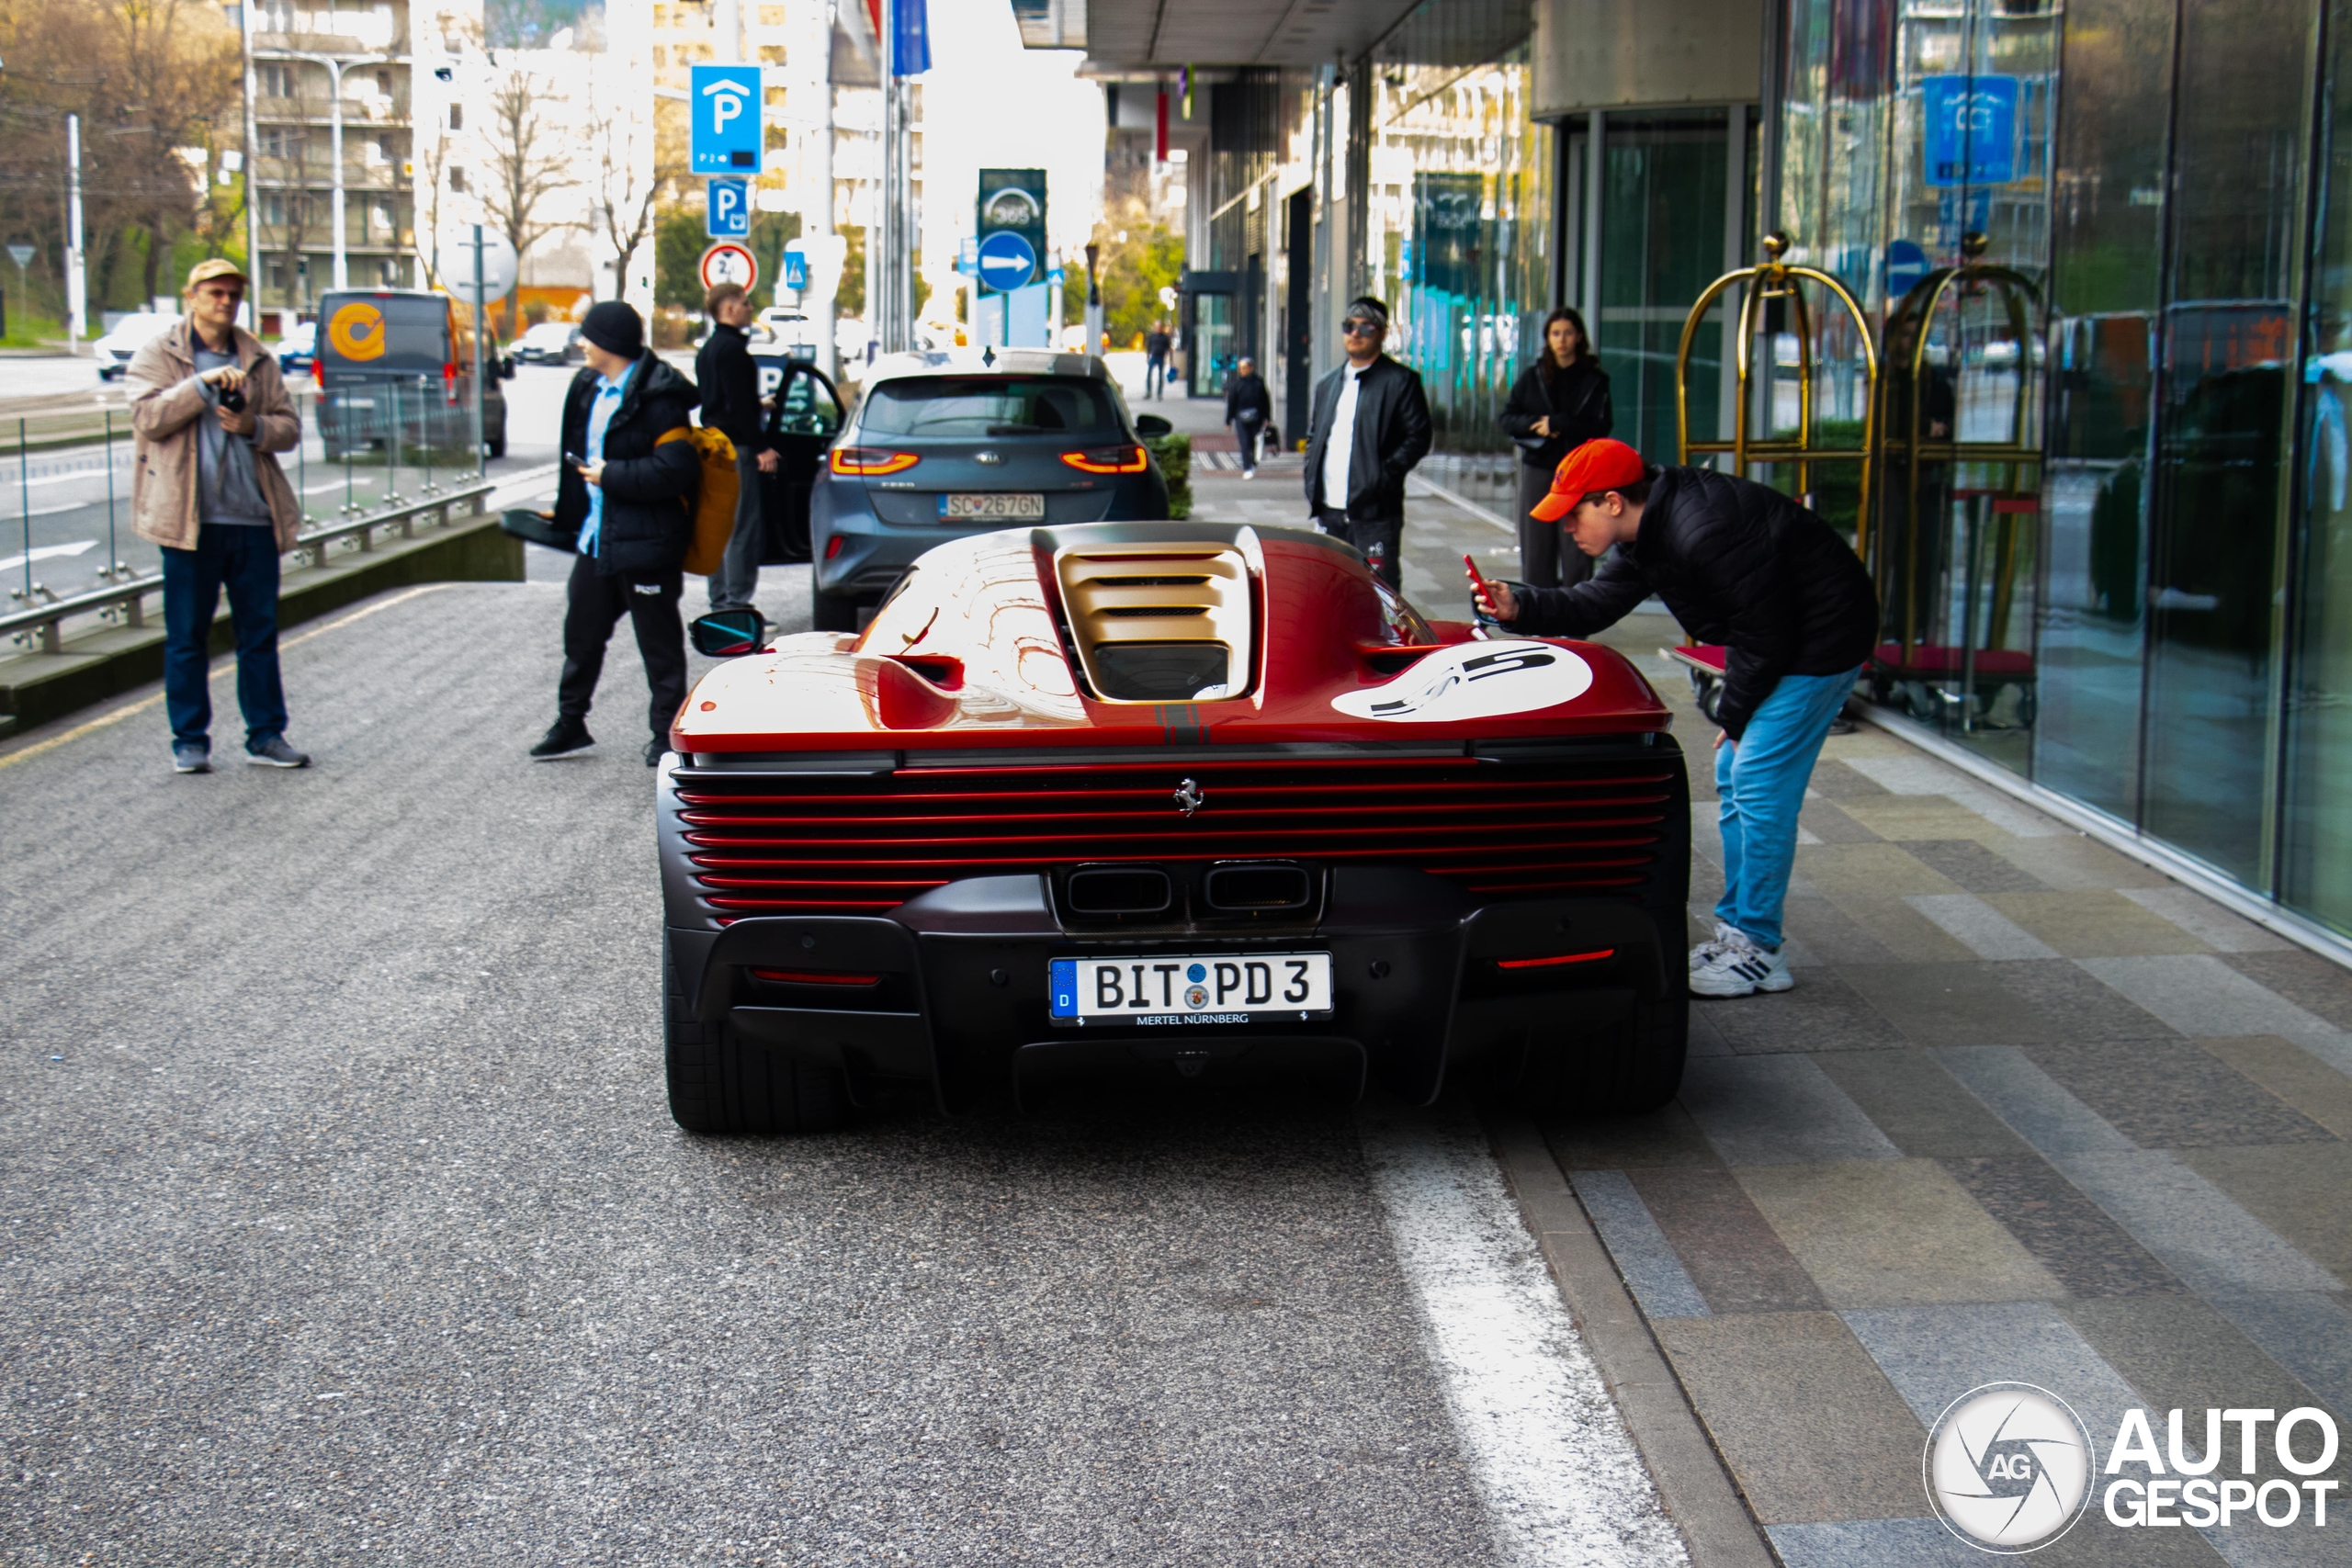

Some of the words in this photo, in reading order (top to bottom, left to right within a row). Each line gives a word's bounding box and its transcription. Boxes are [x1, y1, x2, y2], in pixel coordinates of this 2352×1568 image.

[714, 94, 742, 135] P
[718, 187, 738, 222] P
[950, 496, 974, 514] SC
[983, 496, 1041, 514] 267GN
[1096, 964, 1181, 1009] BIT
[1214, 962, 1272, 1006] PD
[1283, 961, 1309, 1003] 3
[1059, 994, 1069, 1007] D
[1136, 1015, 1182, 1026] MERTEL
[1184, 1013, 1249, 1024] NÜRNBERG
